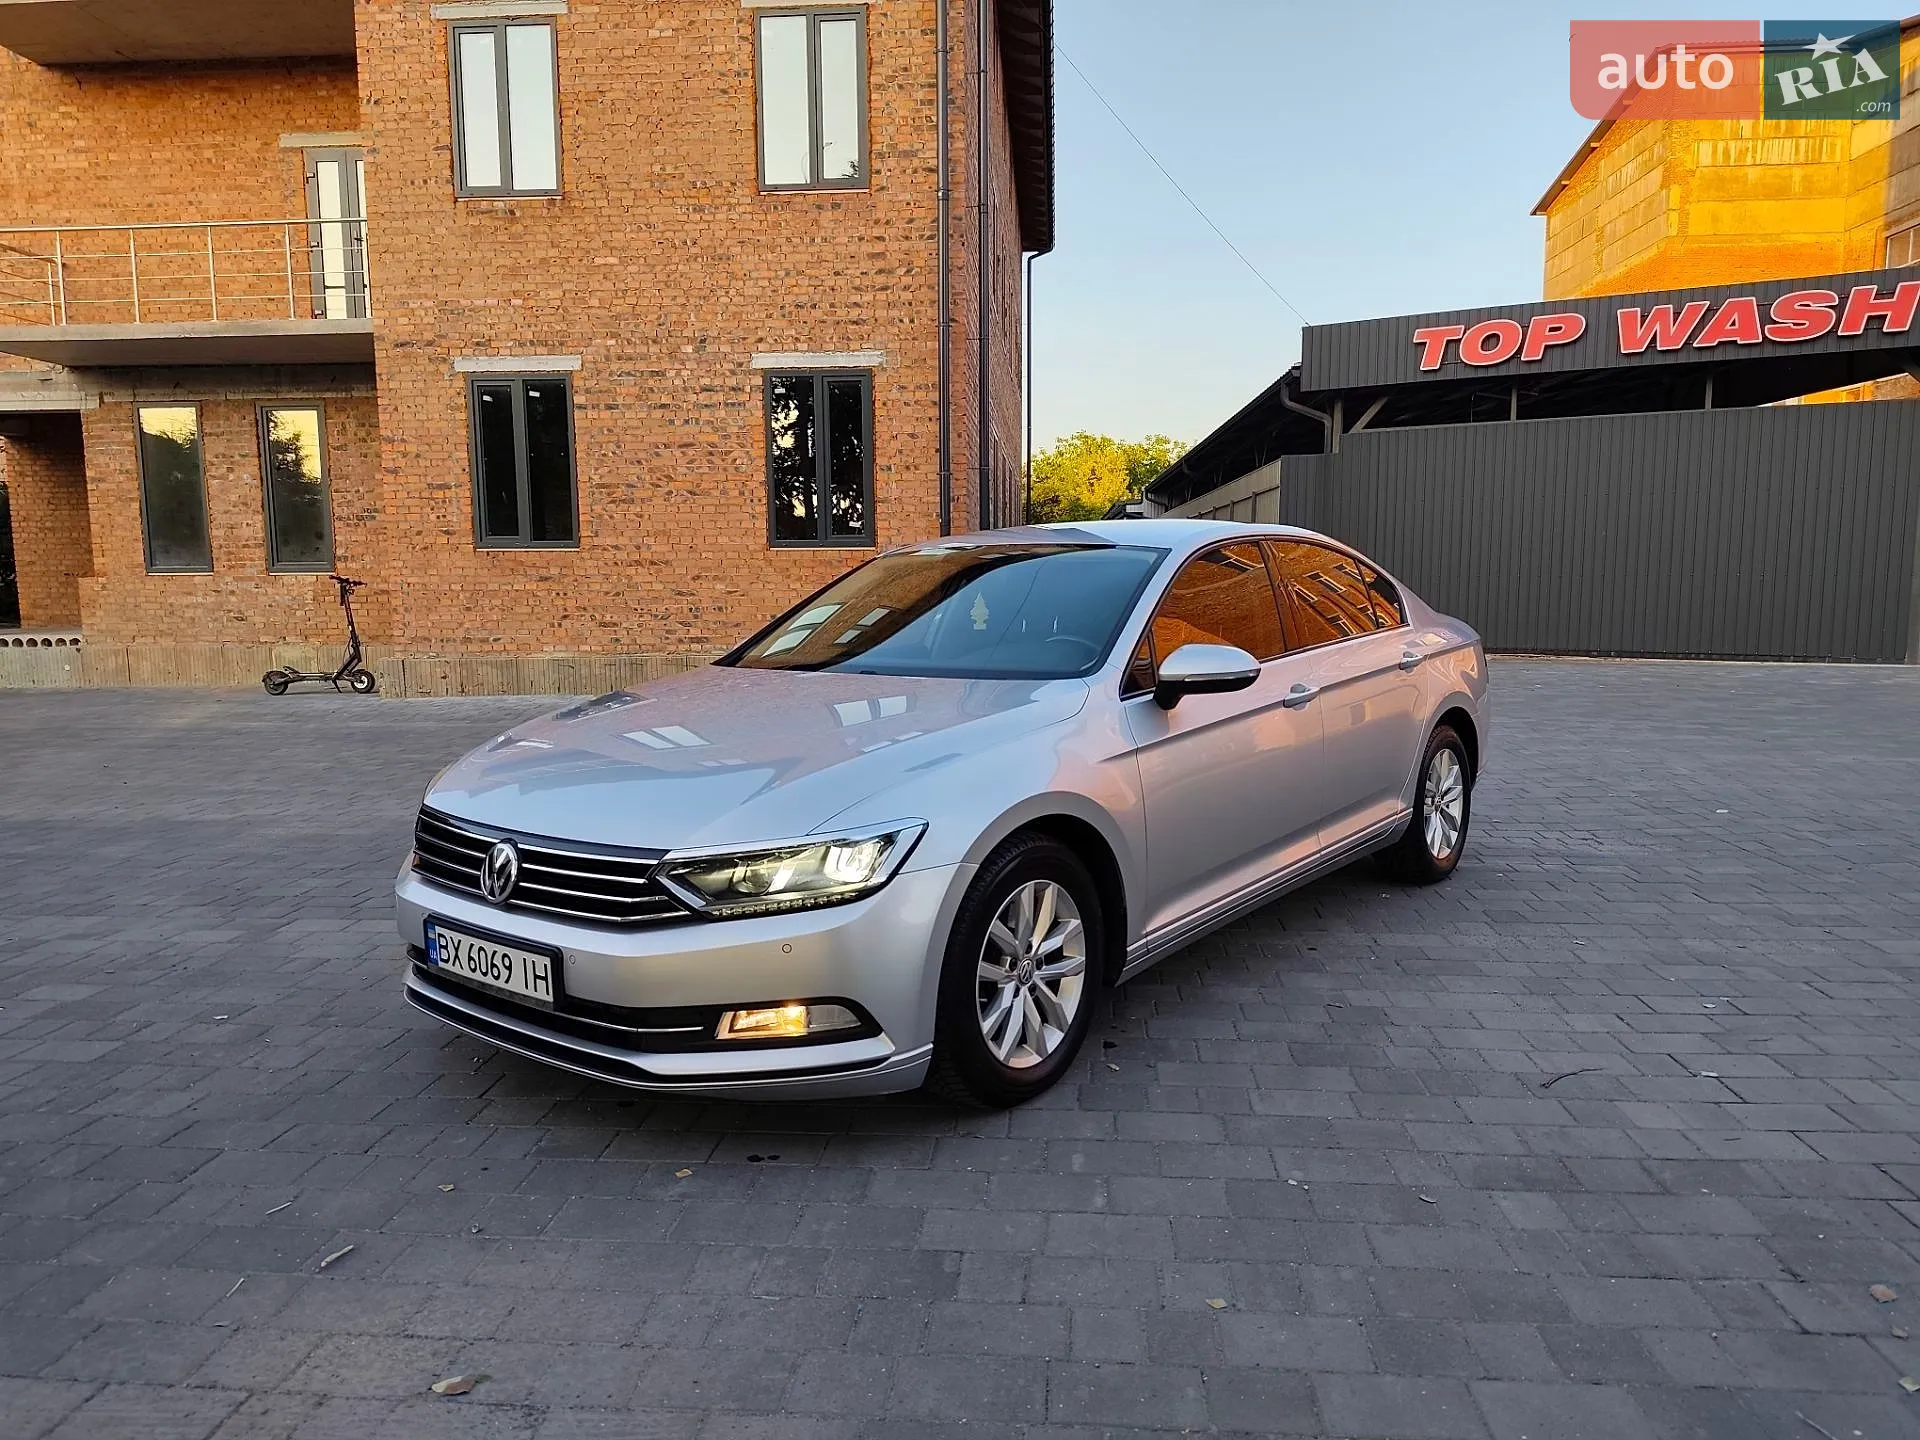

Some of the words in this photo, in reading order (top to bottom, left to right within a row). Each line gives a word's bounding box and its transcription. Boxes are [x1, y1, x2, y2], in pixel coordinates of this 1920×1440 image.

[1413, 313, 1586, 371] TOP
[1617, 281, 1920, 353] WASH
[437, 932, 464, 970] BX
[467, 942, 513, 984] 6069
[522, 957, 550, 996] IH
